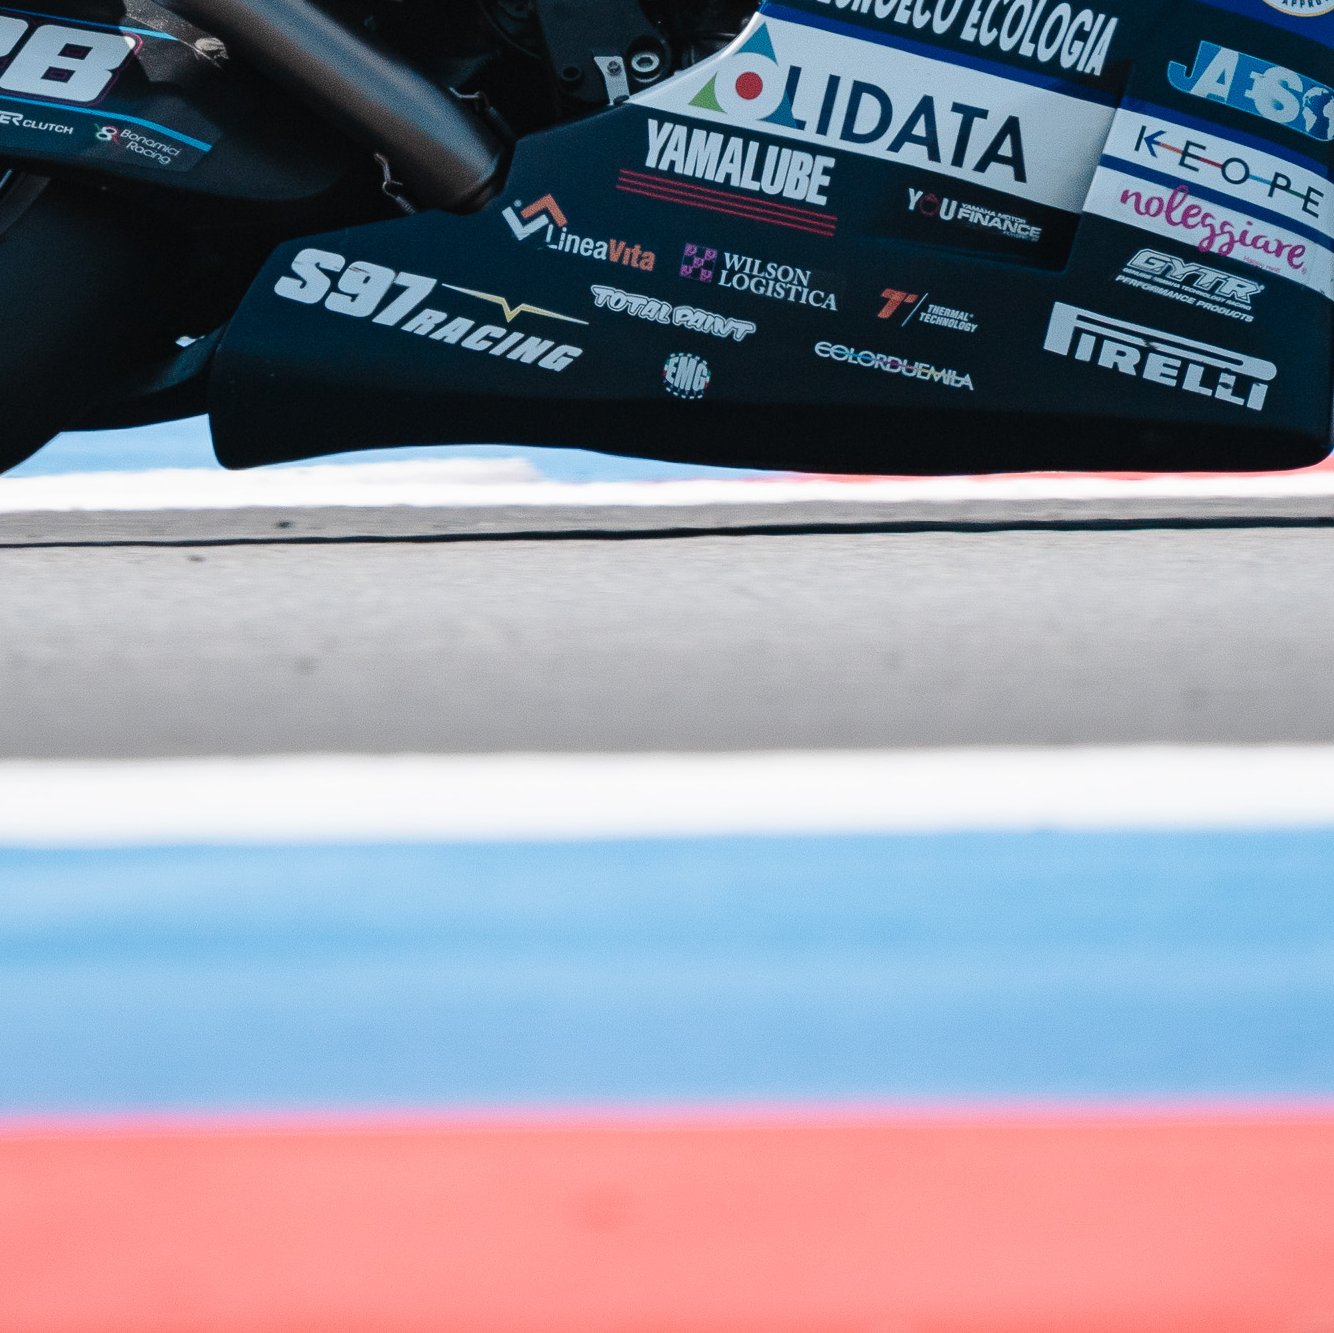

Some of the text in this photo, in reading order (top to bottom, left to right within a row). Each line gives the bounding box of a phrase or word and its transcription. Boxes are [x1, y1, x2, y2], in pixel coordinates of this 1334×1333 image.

[22, 119, 74, 135] CLUTCH
[120, 128, 183, 157] Bonamici
[126, 141, 172, 165] Racing
[645, 119, 835, 206] YAMALUBE
[1133, 125, 1324, 219] KEOPE
[907, 187, 958, 221] YOU
[957, 208, 1043, 237] FINANCE
[961, 202, 1027, 225] YAMAHA MOTOR
[1120, 185, 1306, 270] noleggiare
[544, 223, 656, 272] LineaVita
[273, 248, 437, 327] S97
[723, 252, 812, 287] WILSON
[1127, 248, 1261, 304] GYTR
[718, 269, 839, 311] LOGISTICA
[1115, 274, 1255, 323] PERFORMANCE PRODUCTS
[1152, 275, 1180, 289] YAMAHA
[1181, 284, 1226, 303] TECHNOLOGY
[1225, 298, 1253, 311] RACING
[590, 284, 757, 342] TOTAL PAINT
[918, 312, 979, 333] TECHNOLOGY
[927, 303, 970, 322] THERMAL
[400, 308, 583, 372] RACING
[1043, 301, 1278, 412] PIRELLI
[665, 356, 710, 392] EMG
